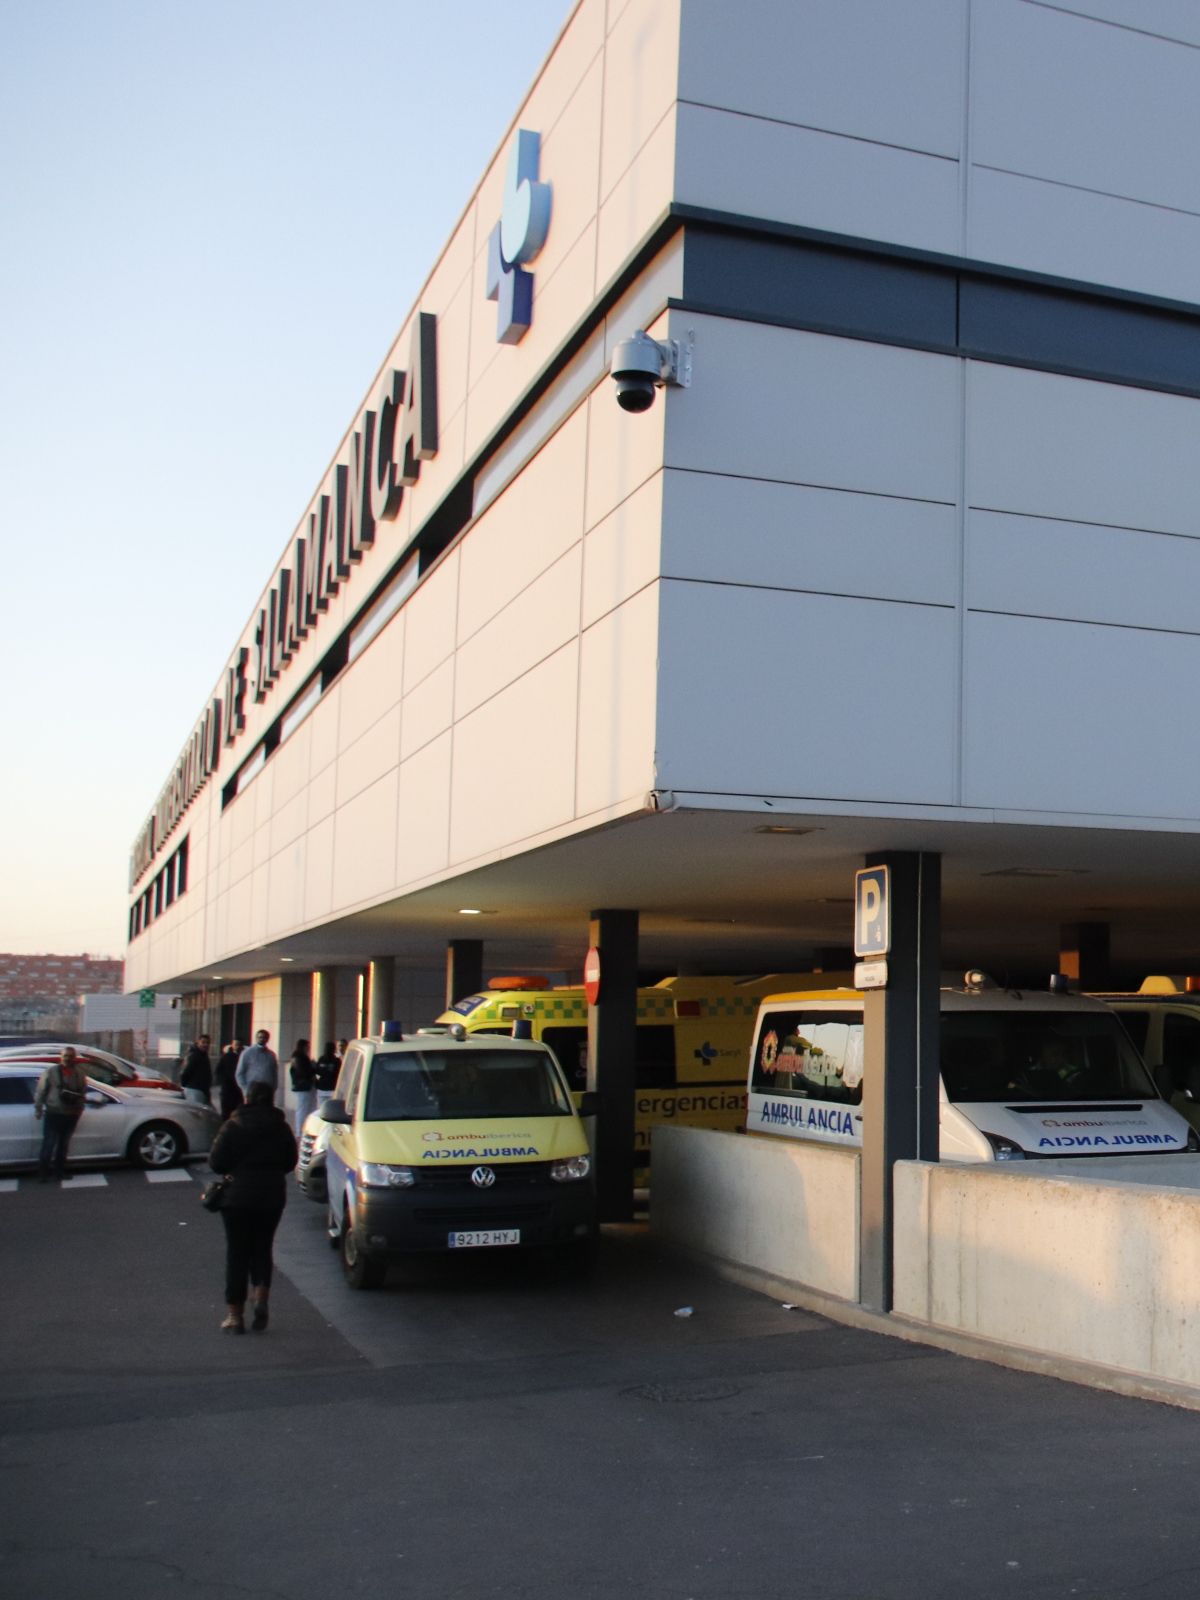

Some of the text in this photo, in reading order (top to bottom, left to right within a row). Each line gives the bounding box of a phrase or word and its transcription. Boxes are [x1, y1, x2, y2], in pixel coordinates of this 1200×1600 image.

[252, 312, 440, 705] SALAMANCA
[861, 879, 881, 945] P
[637, 1092, 748, 1118] ergencias
[762, 1101, 856, 1137] AMBULANCIA
[457, 1231, 518, 1246] 9212 HYJ
